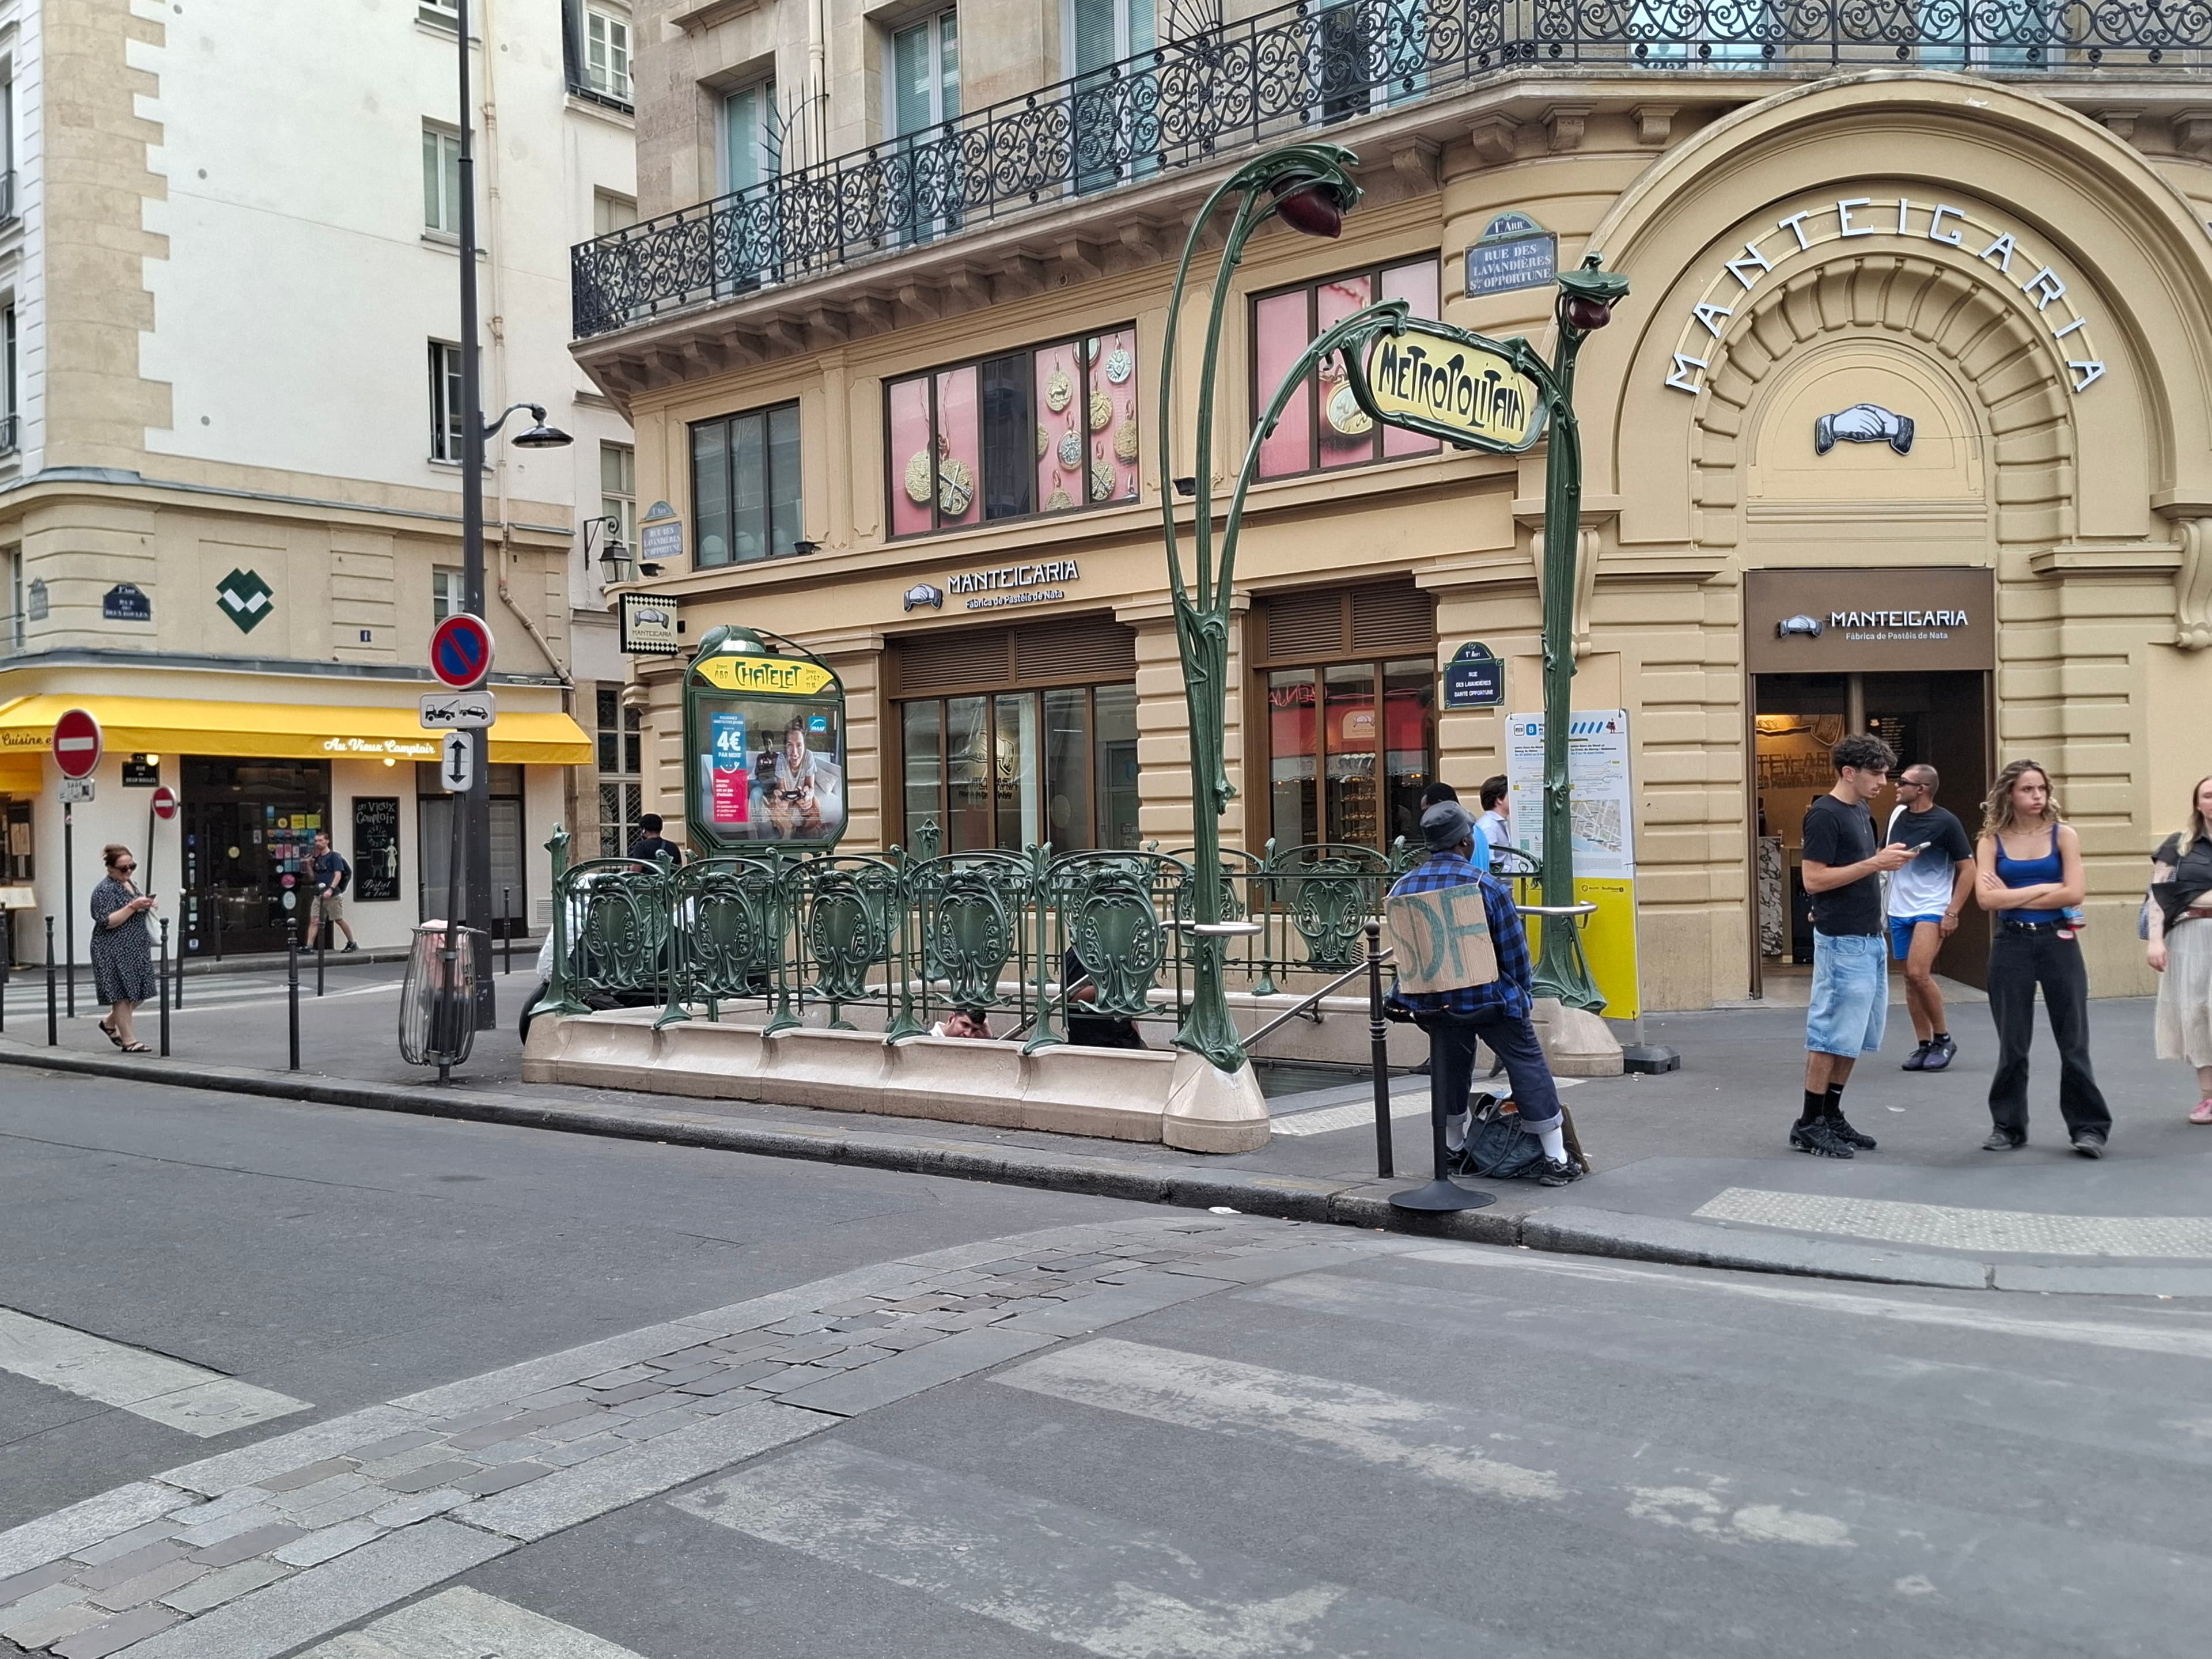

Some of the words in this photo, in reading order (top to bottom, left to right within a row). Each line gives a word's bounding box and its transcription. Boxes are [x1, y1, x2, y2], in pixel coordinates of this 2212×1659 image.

[1484, 248, 1509, 262] RUE
[1514, 244, 1537, 257] DES
[1474, 255, 1552, 276] LAVANDIÈRES
[1484, 268, 1551, 288] OPPORTUNE
[1665, 197, 2107, 395] MANTEIGARIA
[1378, 342, 1527, 433] METROPOLITAIN
[650, 528, 661, 537] RUE
[663, 527, 674, 535] DES
[947, 559, 1079, 594] MANTEIGARIA
[993, 596, 1003, 606] de
[1033, 591, 1043, 601] de
[1044, 589, 1063, 600] Nata
[1831, 610, 1968, 627] MANTEIGARIA
[632, 630, 672, 638] MANTEIGARIA
[1846, 632, 1875, 640] Fábrica
[1918, 631, 1927, 639] de
[1930, 631, 1948, 639] Nata
[2, 732, 43, 746] Cuisine
[324, 737, 347, 751] Au
[348, 738, 383, 752] Vieux
[384, 739, 435, 757] Comptoir
[717, 731, 741, 751] 4€
[368, 801, 396, 812] Vieux
[356, 811, 395, 825] Comptoir
[1386, 884, 1488, 983] SDF
